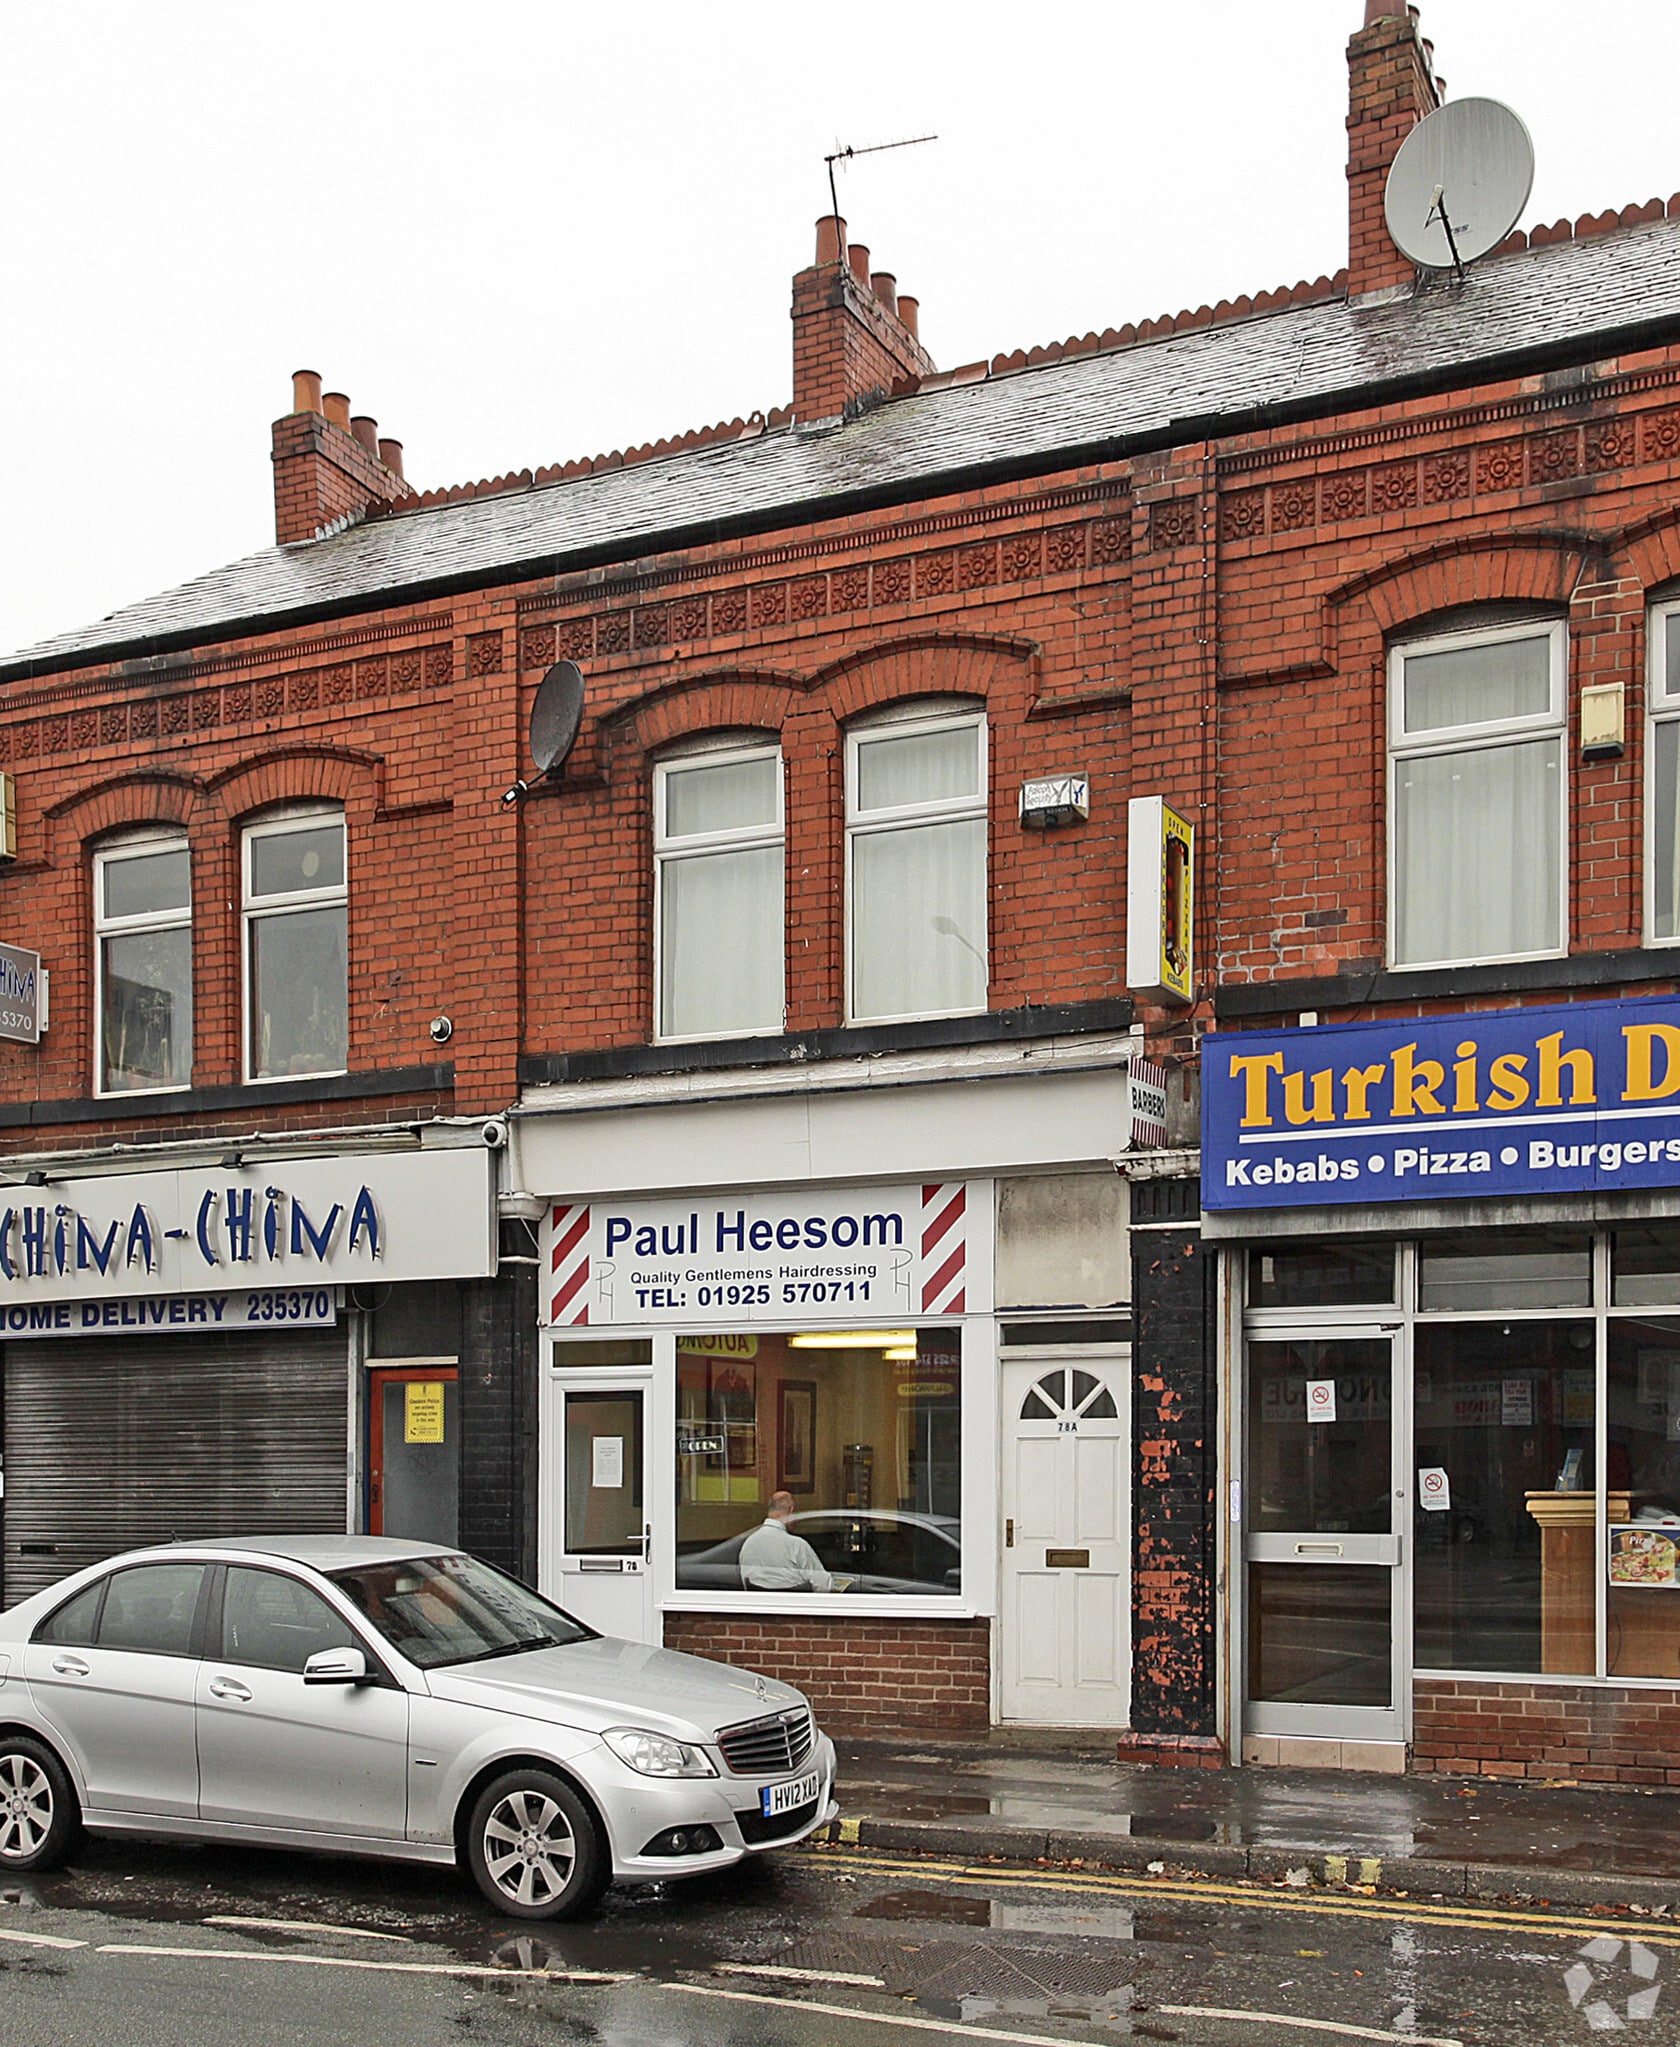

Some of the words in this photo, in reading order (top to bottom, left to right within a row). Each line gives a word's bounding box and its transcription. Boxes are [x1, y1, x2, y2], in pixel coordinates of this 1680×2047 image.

[1168, 817, 1184, 836] OPEN
[0, 1010, 32, 1030] 5370
[1229, 1030, 1598, 1128] Turkish
[1131, 1086, 1165, 1120] BARBERS
[1226, 1154, 1360, 1187] Kebabs
[1394, 1147, 1491, 1177] Pizza
[1529, 1138, 1680, 1171] Burgers
[606, 1213, 698, 1258] Paul
[716, 1210, 903, 1253] Heesom
[630, 1271, 681, 1285] Quality
[685, 1268, 773, 1282] Gentlemens
[779, 1263, 877, 1278] Hairdressing
[635, 1288, 687, 1308] TEL:
[697, 1285, 770, 1307] 01925
[782, 1281, 870, 1304] 570711
[82, 1297, 229, 1328] DELIVERY
[247, 1290, 329, 1321] 235370
[1058, 1422, 1078, 1432] 78A
[688, 1440, 718, 1452] OPEN
[626, 1560, 638, 1571] 78
[774, 1783, 801, 1811] HV12
